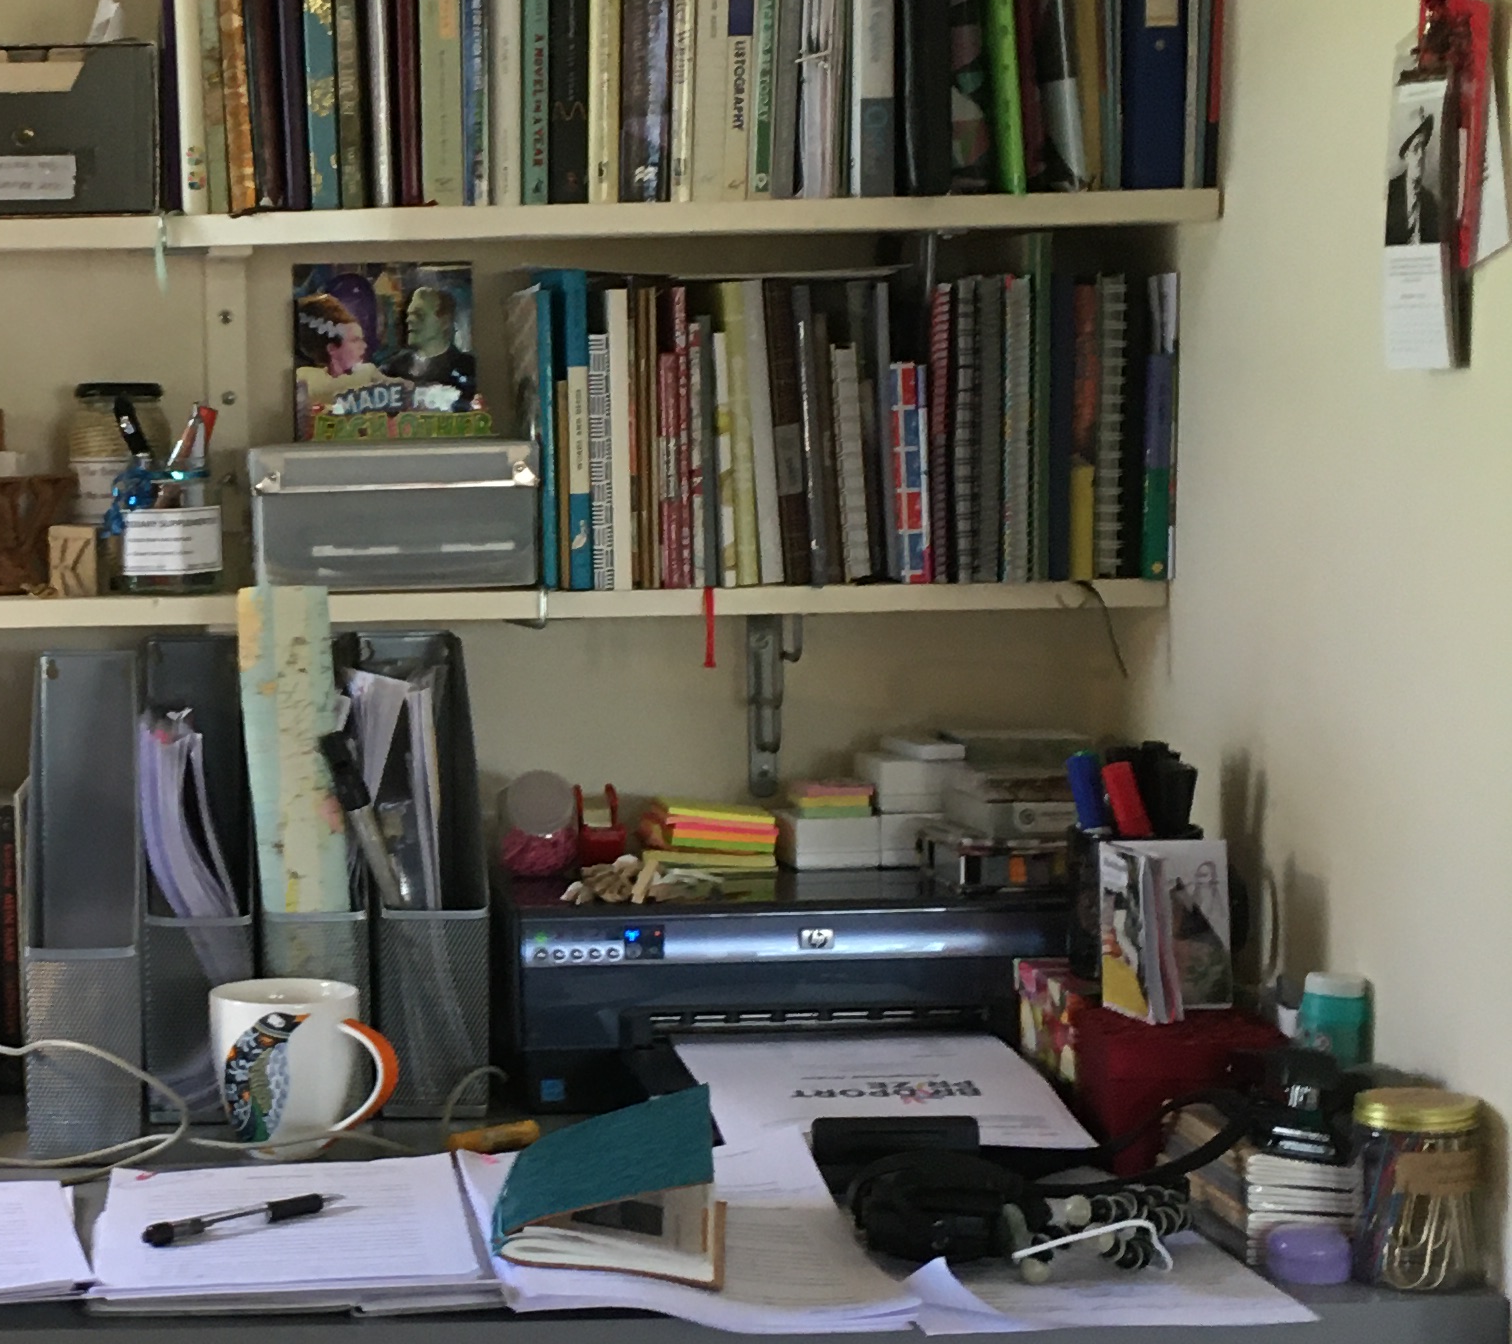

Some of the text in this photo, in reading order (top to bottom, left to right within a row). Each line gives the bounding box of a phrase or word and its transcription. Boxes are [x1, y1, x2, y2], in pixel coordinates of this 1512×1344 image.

[534, 33, 544, 43] A
[533, 47, 544, 96] NOVEL
[732, 40, 747, 131] LISTOGRAPHY
[533, 99, 541, 113] IN
[758, 76, 770, 122] TODAY
[533, 117, 543, 125] A
[533, 128, 544, 168] YEAR
[333, 386, 402, 413] MADE
[314, 411, 492, 441] EACH OTHER
[808, 930, 827, 948] hp
